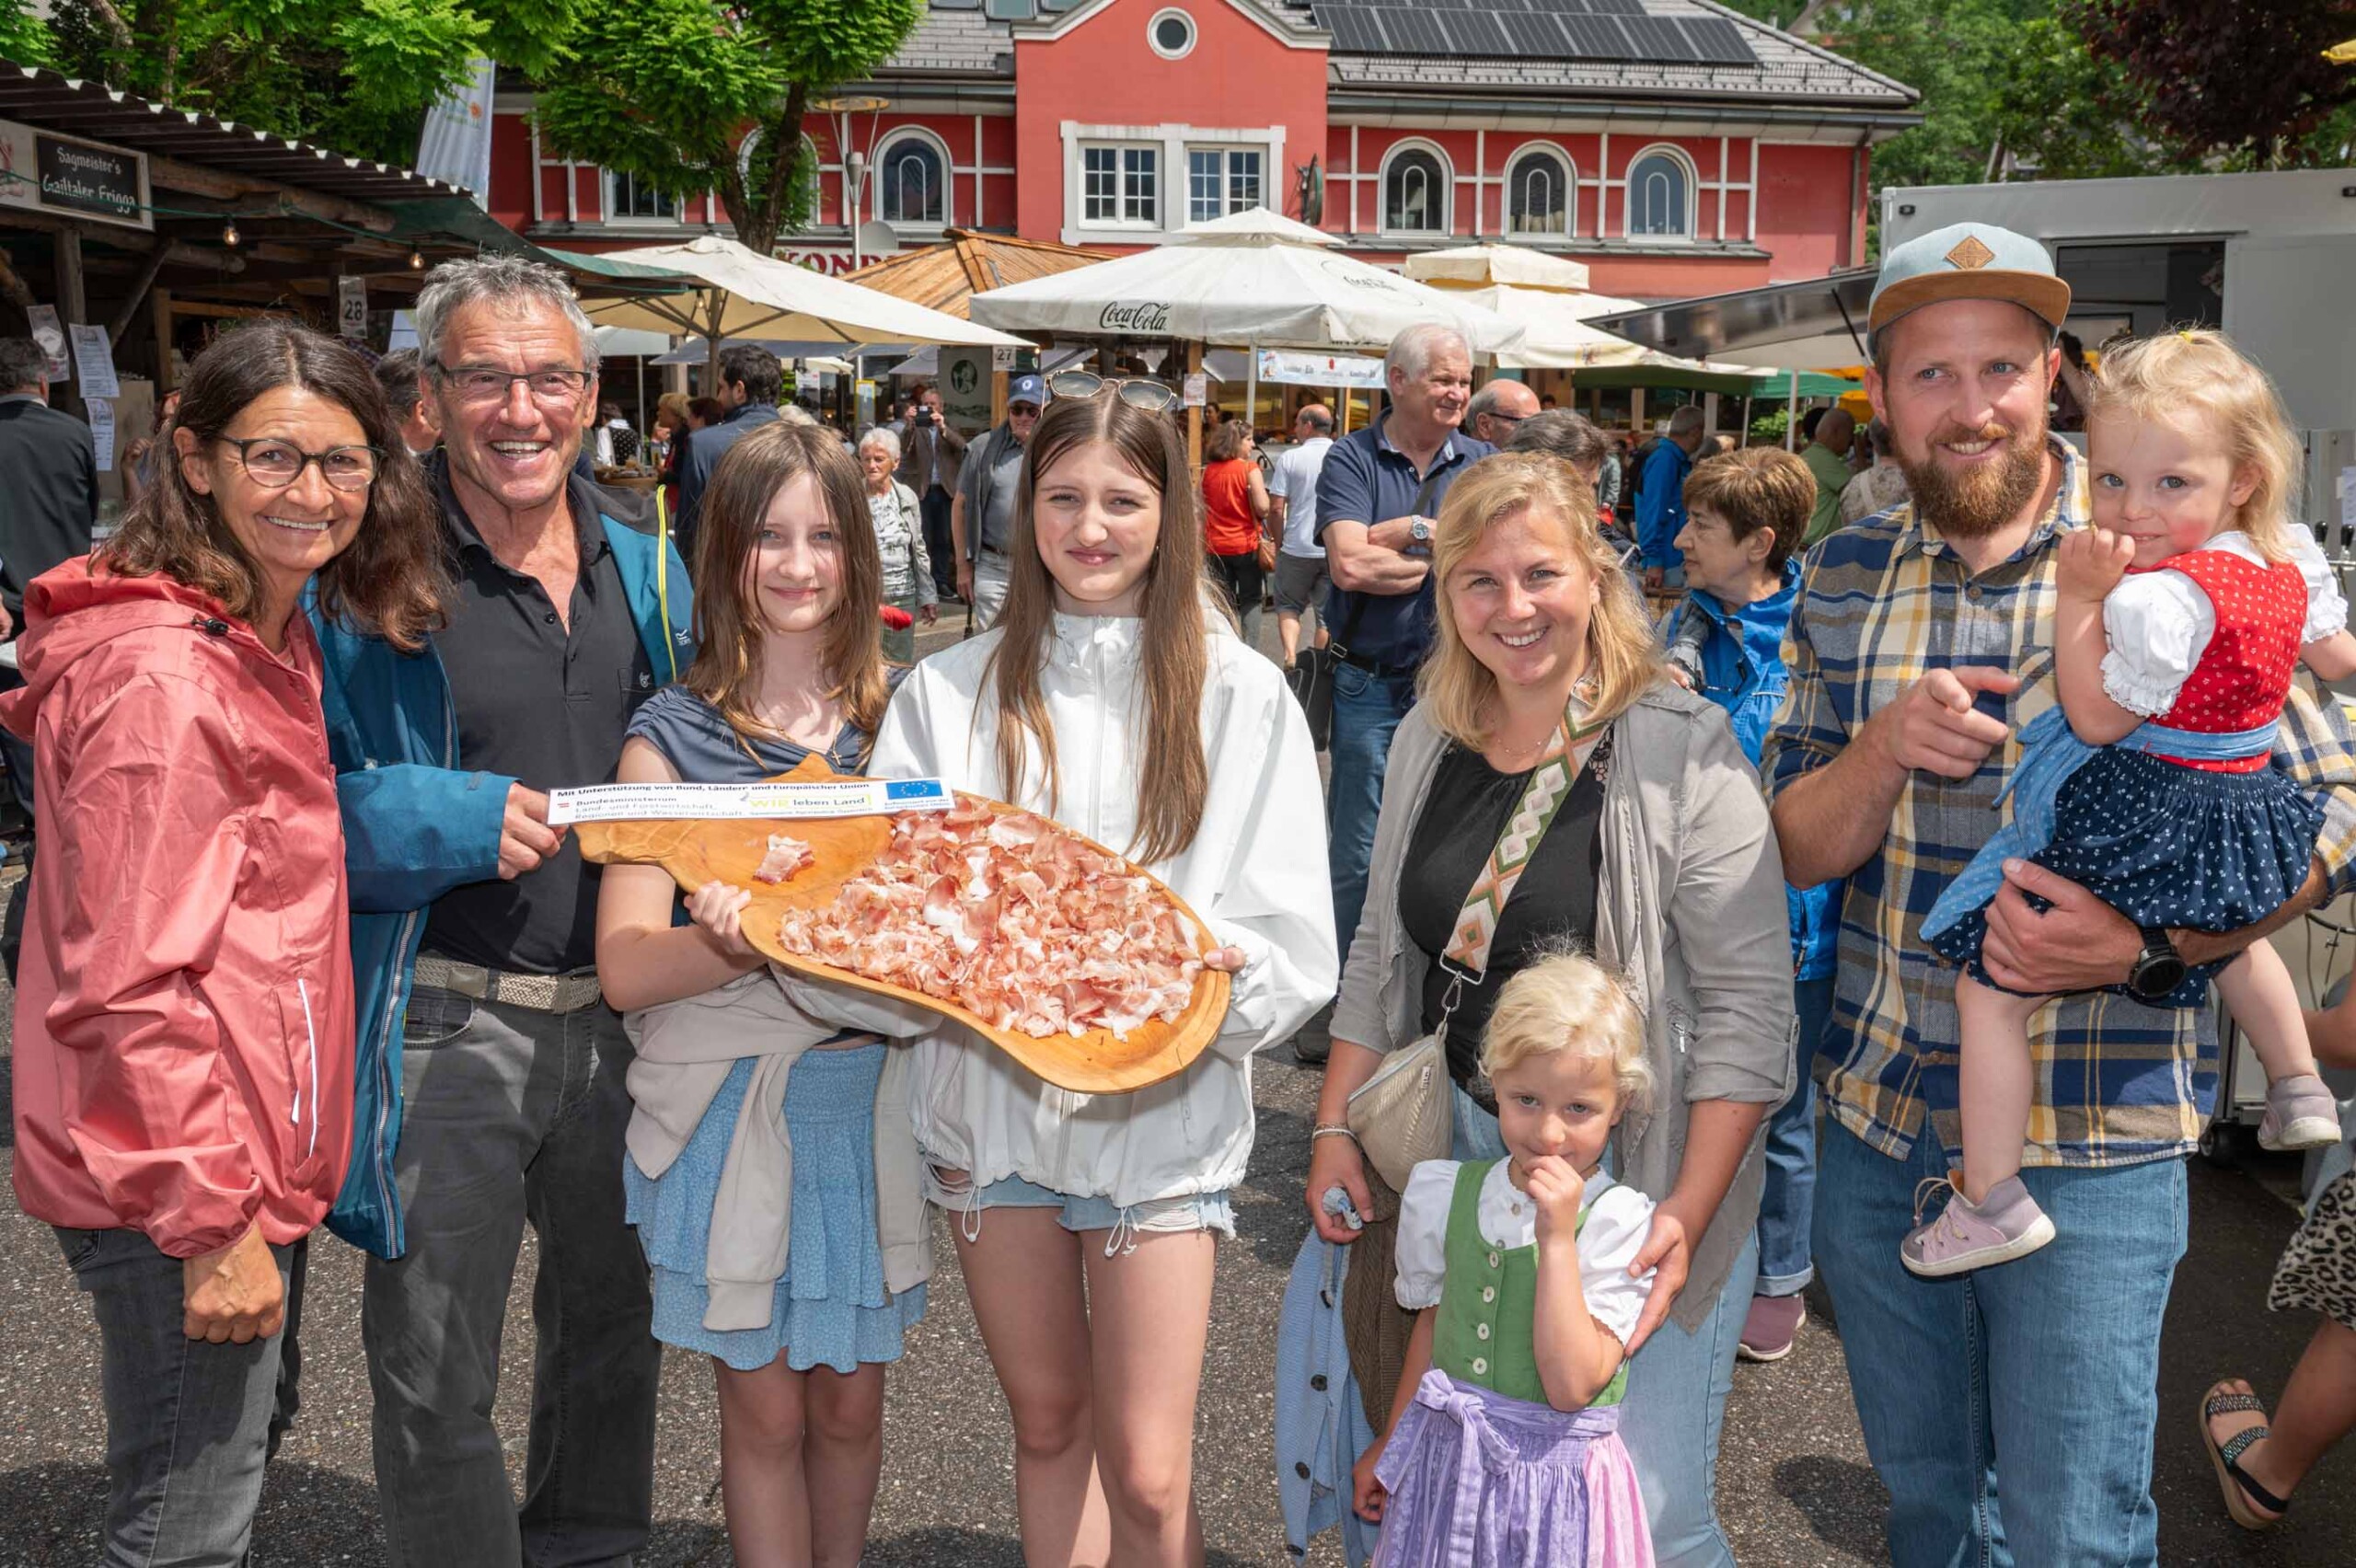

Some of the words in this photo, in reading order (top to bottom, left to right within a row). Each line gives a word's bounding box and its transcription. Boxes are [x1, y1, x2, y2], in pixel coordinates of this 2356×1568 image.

[57, 146, 121, 175] Sagmeister's
[42, 174, 95, 199] Gailtaler
[98, 185, 136, 214] Frigga
[344, 299, 363, 321] 28
[1100, 301, 1171, 331] Coca-Cola
[997, 349, 1012, 361] 27
[578, 786, 652, 795] Unterstützung
